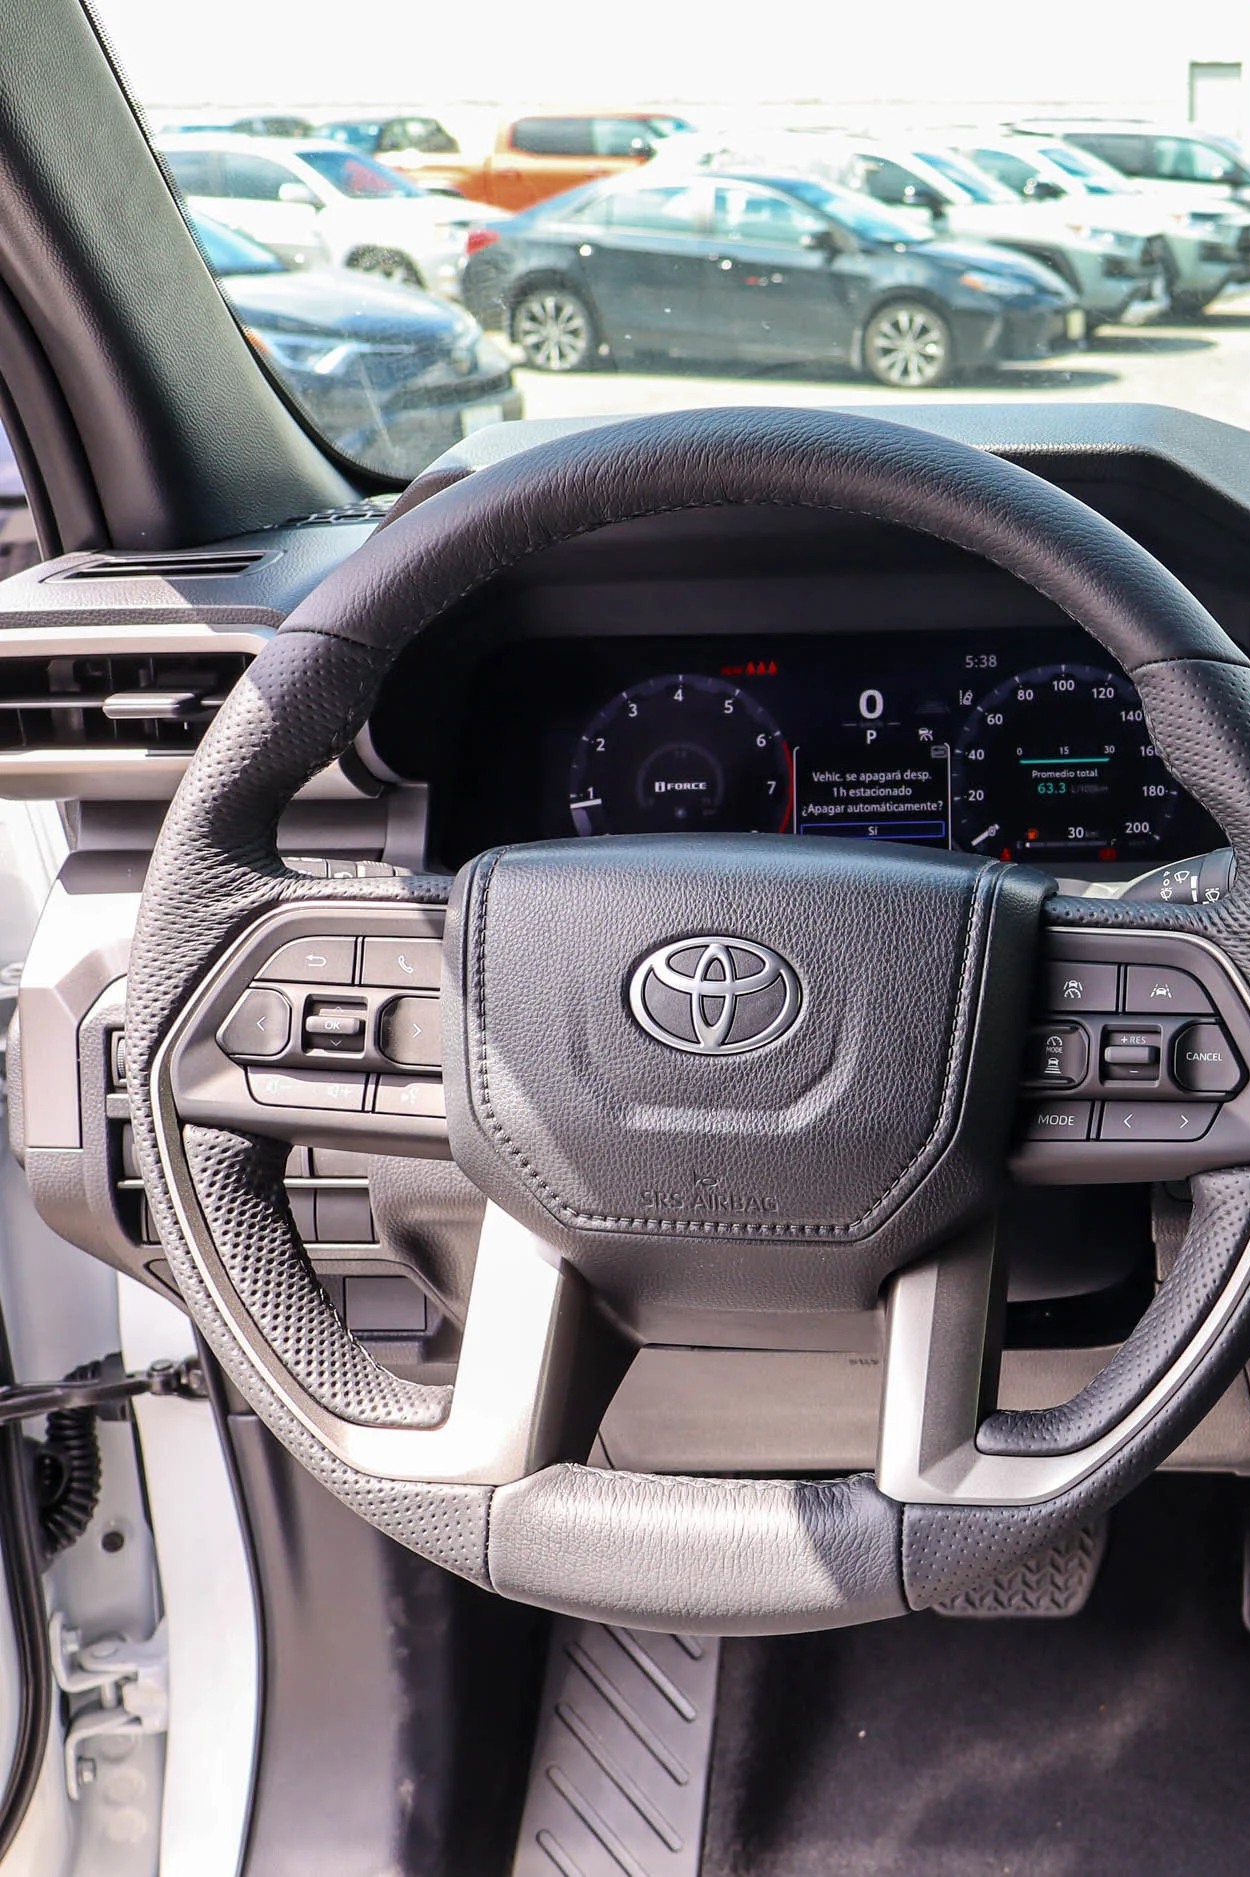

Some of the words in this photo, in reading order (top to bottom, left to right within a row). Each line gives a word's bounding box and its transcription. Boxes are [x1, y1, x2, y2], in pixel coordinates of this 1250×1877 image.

[965, 655, 997, 668] 5:38
[1052, 680, 1075, 691] 100
[674, 689, 683, 702] 4
[1017, 689, 1033, 700] 80
[1092, 688, 1114, 699] 120
[724, 700, 734, 714] 5
[859, 689, 884, 719] 0
[628, 704, 638, 717] 3
[1120, 710, 1143, 722] 140
[987, 713, 1003, 725] 60
[756, 734, 767, 747] 6
[866, 730, 877, 744] P
[596, 738, 605, 752] 2
[1017, 747, 1023, 755] 0
[1059, 746, 1070, 755] 15
[1104, 745, 1115, 754] 30
[968, 749, 985, 761] 40
[845, 773, 857, 781] se
[860, 770, 900, 783] apagará
[903, 769, 932, 782] desp.
[1032, 770, 1075, 779] Promedio
[1077, 769, 1098, 778] total
[587, 787, 594, 799] 1
[767, 781, 777, 795] 7
[849, 785, 912, 797] estacionado
[1037, 782, 1067, 794] 63.3
[1142, 785, 1165, 797] 180
[968, 790, 984, 801] 20
[802, 804, 844, 816] ¿Apagar
[847, 801, 943, 814] automáticamente?
[1067, 827, 1084, 839] 30
[1125, 821, 1149, 834] 200
[324, 1020, 340, 1030] OK
[1046, 1046, 1063, 1054] MODE
[1186, 1052, 1223, 1062] CANCEL
[1038, 1115, 1075, 1126] MODE
[641, 1191, 685, 1208] SRS
[695, 1193, 780, 1212] AIRBAG
